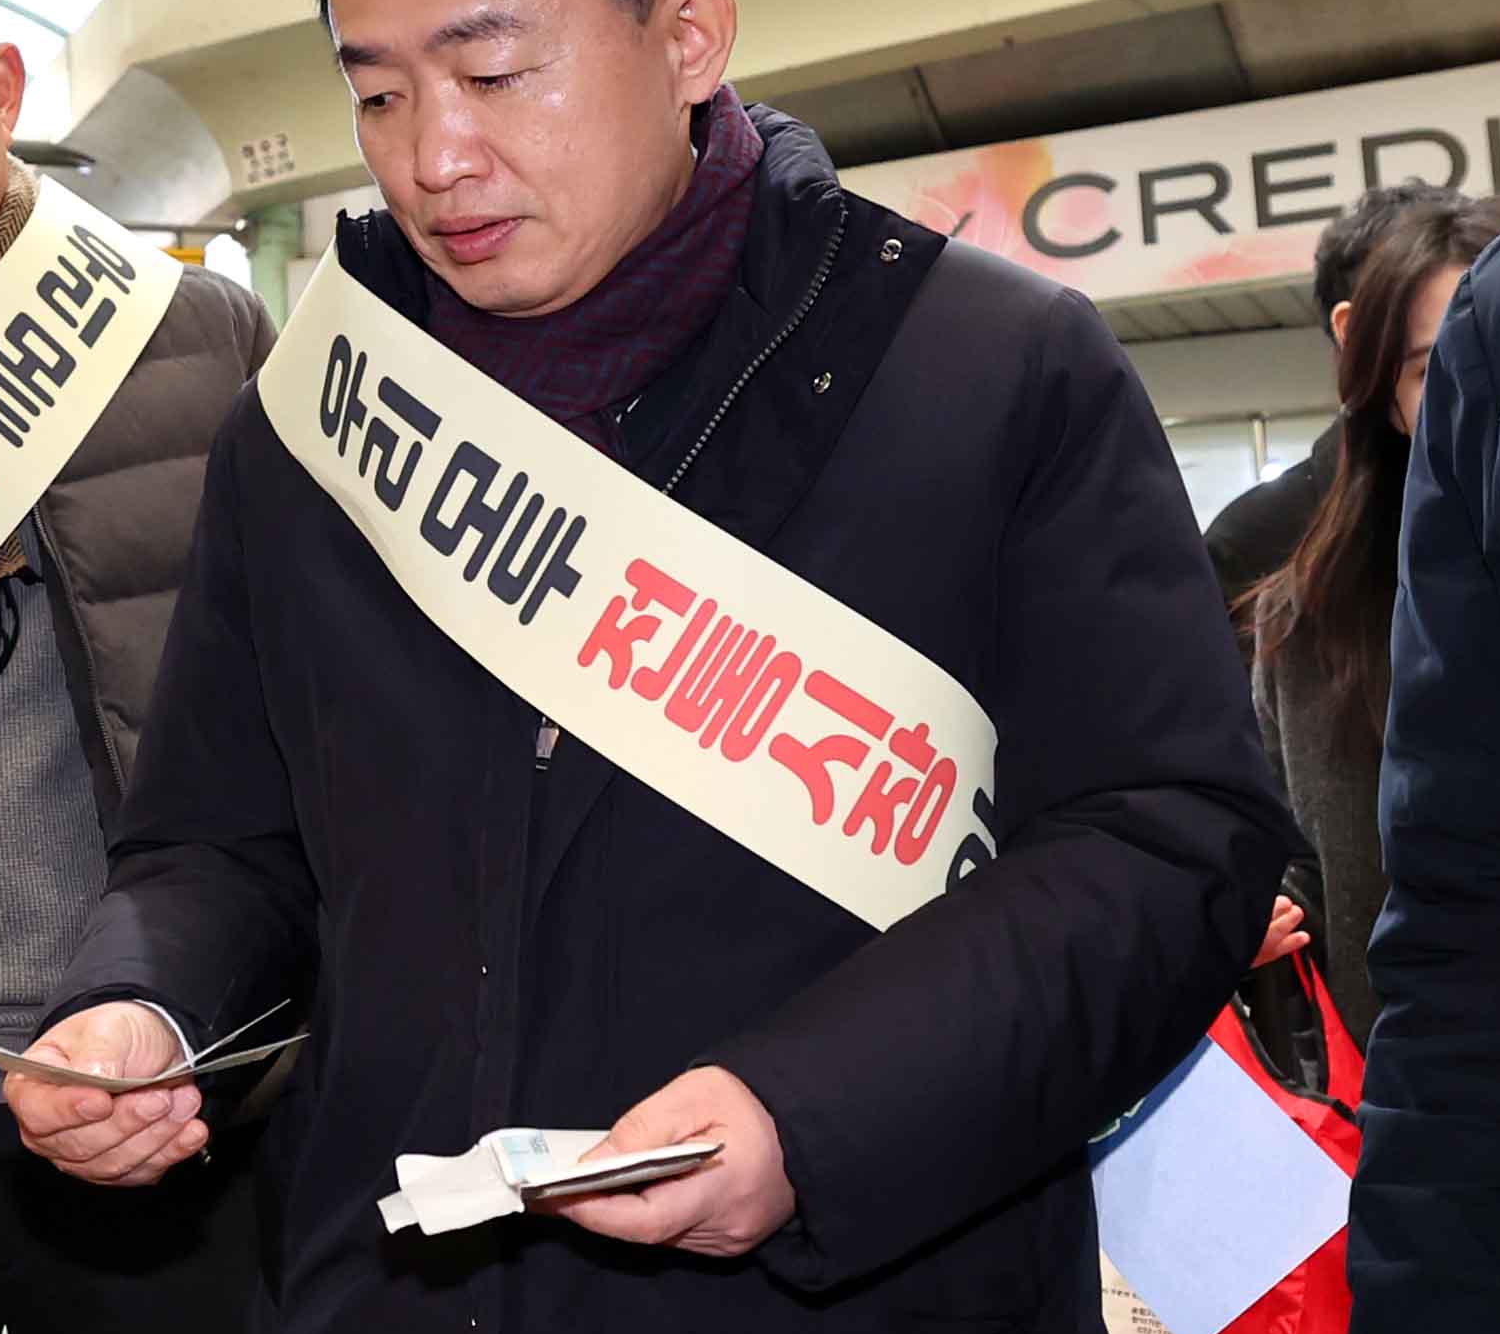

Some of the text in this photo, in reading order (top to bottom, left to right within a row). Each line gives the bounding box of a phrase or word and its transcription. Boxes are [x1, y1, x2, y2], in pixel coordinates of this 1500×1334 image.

[46, 218, 139, 349] 우리
[318, 331, 440, 513] 우리
[418, 438, 585, 627] 모두
[576, 557, 957, 866] 전통시장
